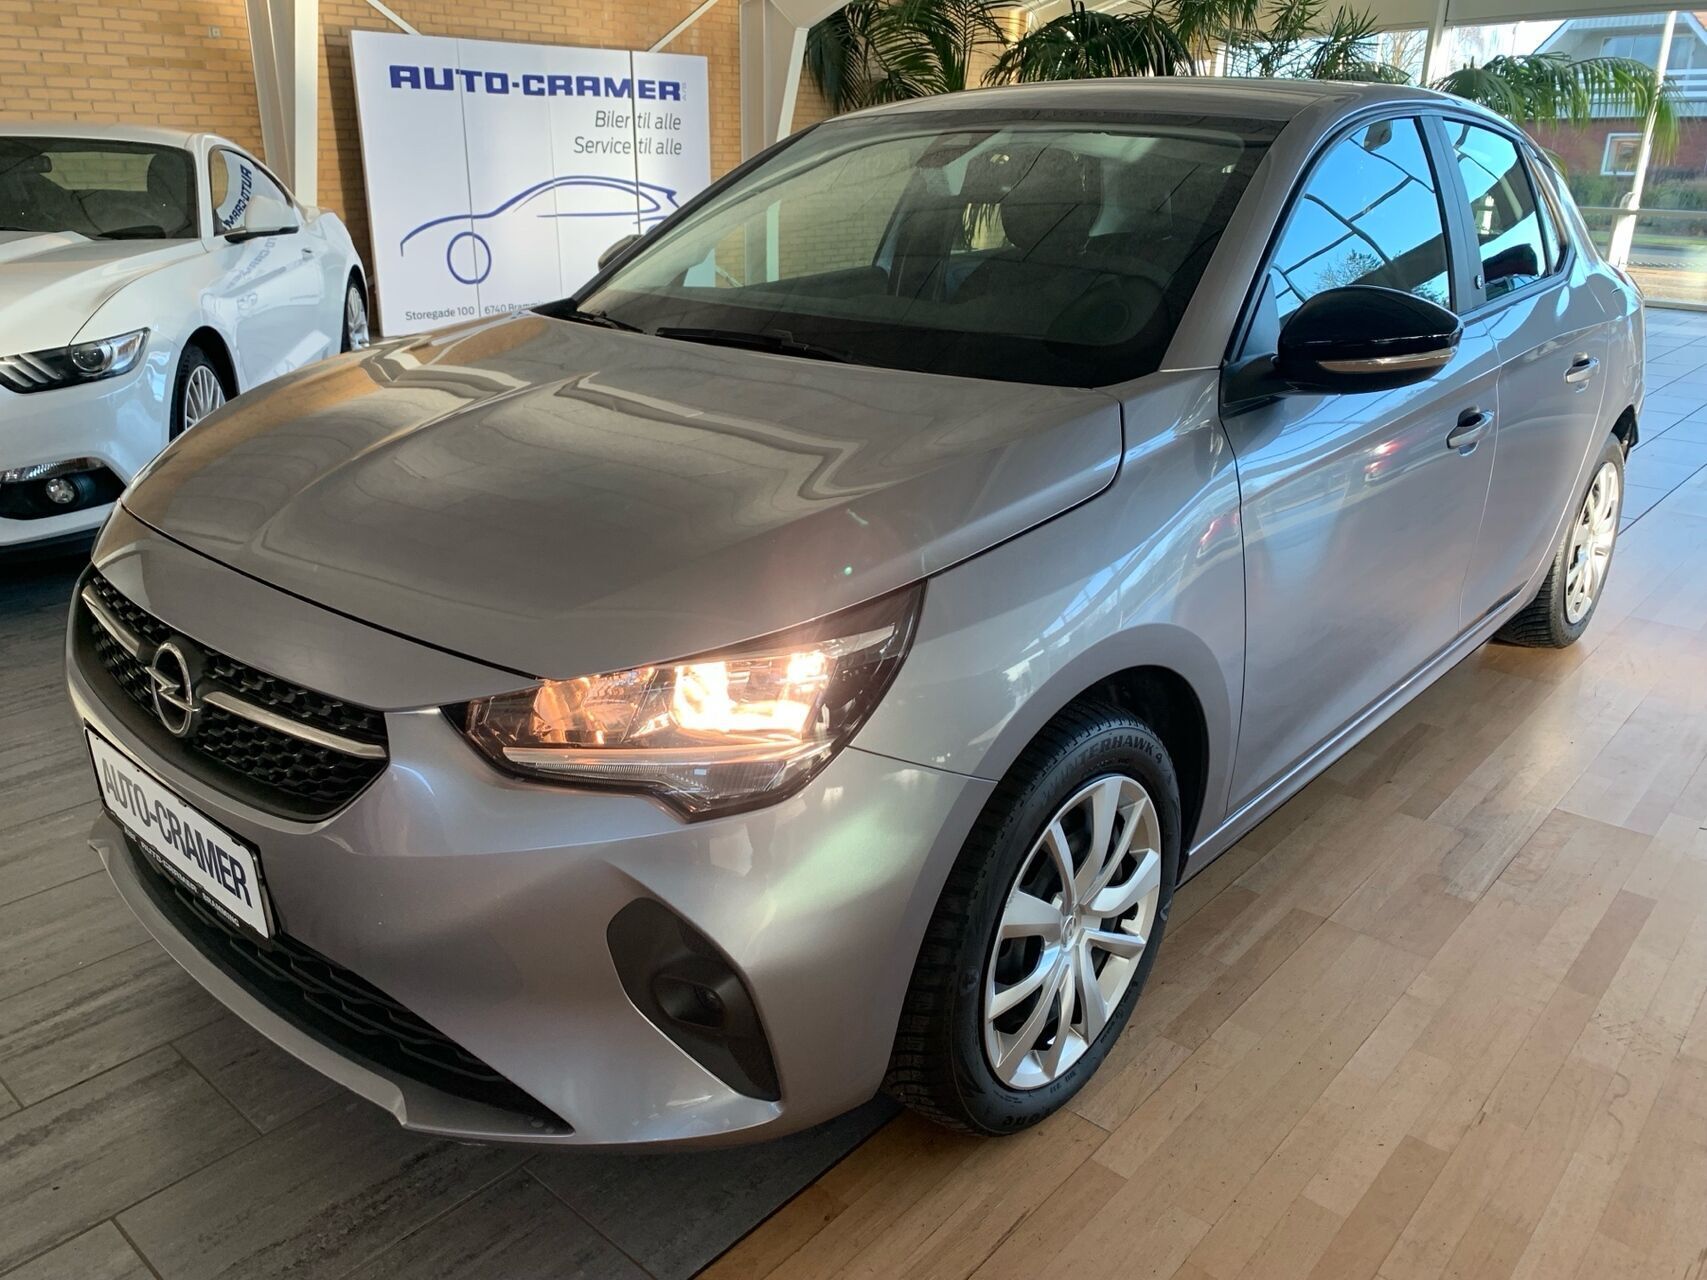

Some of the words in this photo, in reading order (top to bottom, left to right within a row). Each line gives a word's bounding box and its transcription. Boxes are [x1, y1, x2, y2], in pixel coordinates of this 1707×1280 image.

[389, 65, 681, 101] AUTO-CRAMER
[595, 110, 630, 129] Biler
[637, 112, 651, 129] til
[654, 113, 682, 131] alle
[573, 137, 631, 154] Service
[638, 138, 652, 154] til
[655, 138, 683, 155] alle
[405, 308, 456, 321] Storegade
[457, 306, 475, 315] 100
[484, 304, 507, 315] 6740
[102, 758, 253, 909] AUTO-CRAMER
